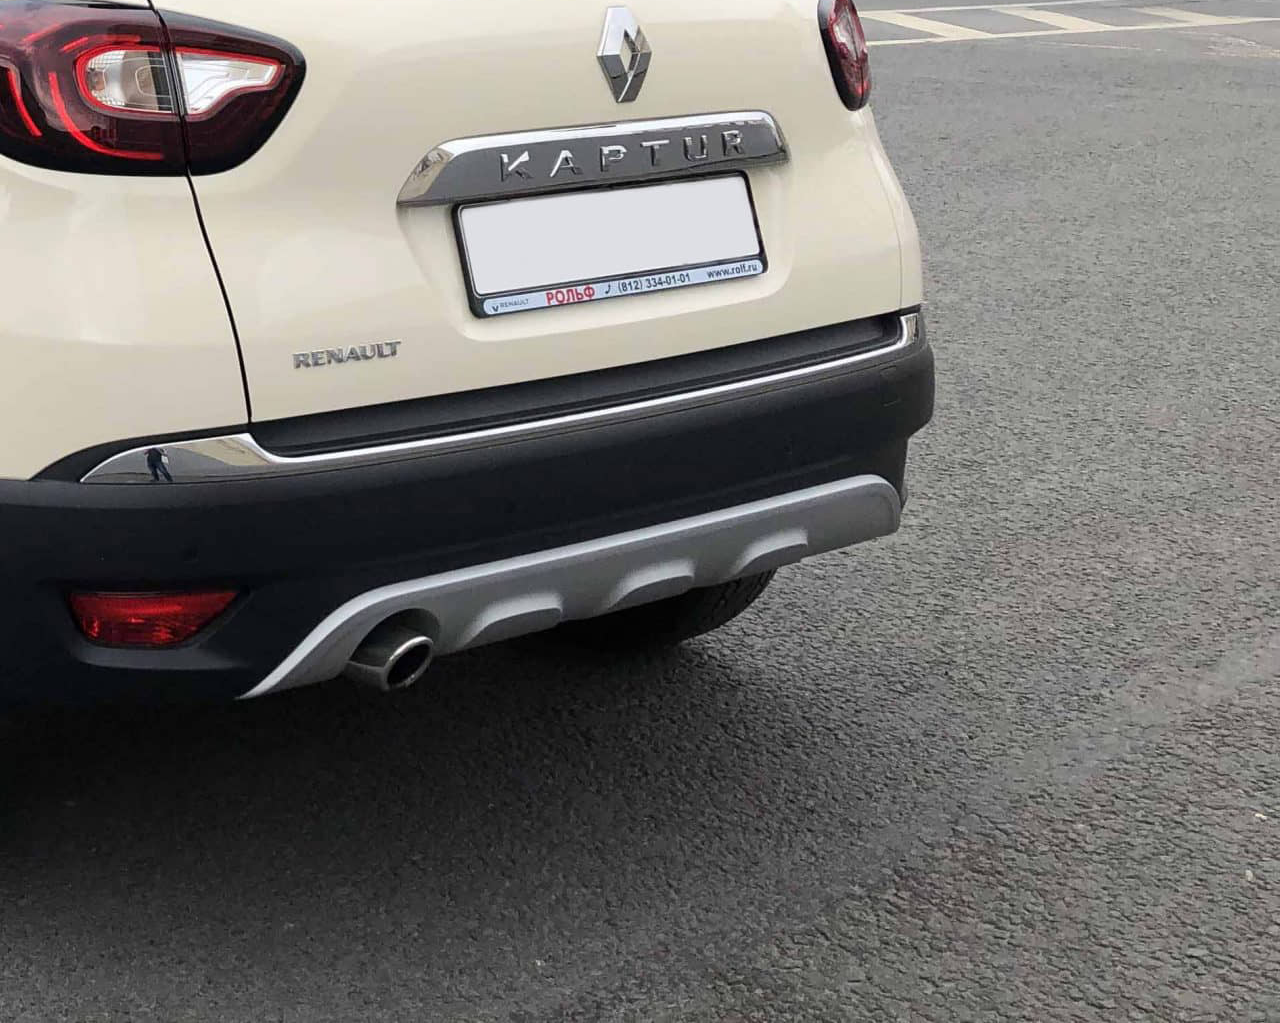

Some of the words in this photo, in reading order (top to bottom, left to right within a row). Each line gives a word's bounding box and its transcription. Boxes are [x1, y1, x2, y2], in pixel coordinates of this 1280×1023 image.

[499, 129, 746, 183] KAPTUR
[705, 262, 758, 280] www.rolf.ru
[617, 279, 643, 294] (812)
[645, 272, 691, 290] 334-01-01
[545, 284, 596, 306] РОЛЬФ
[292, 340, 402, 370] RENAULT
